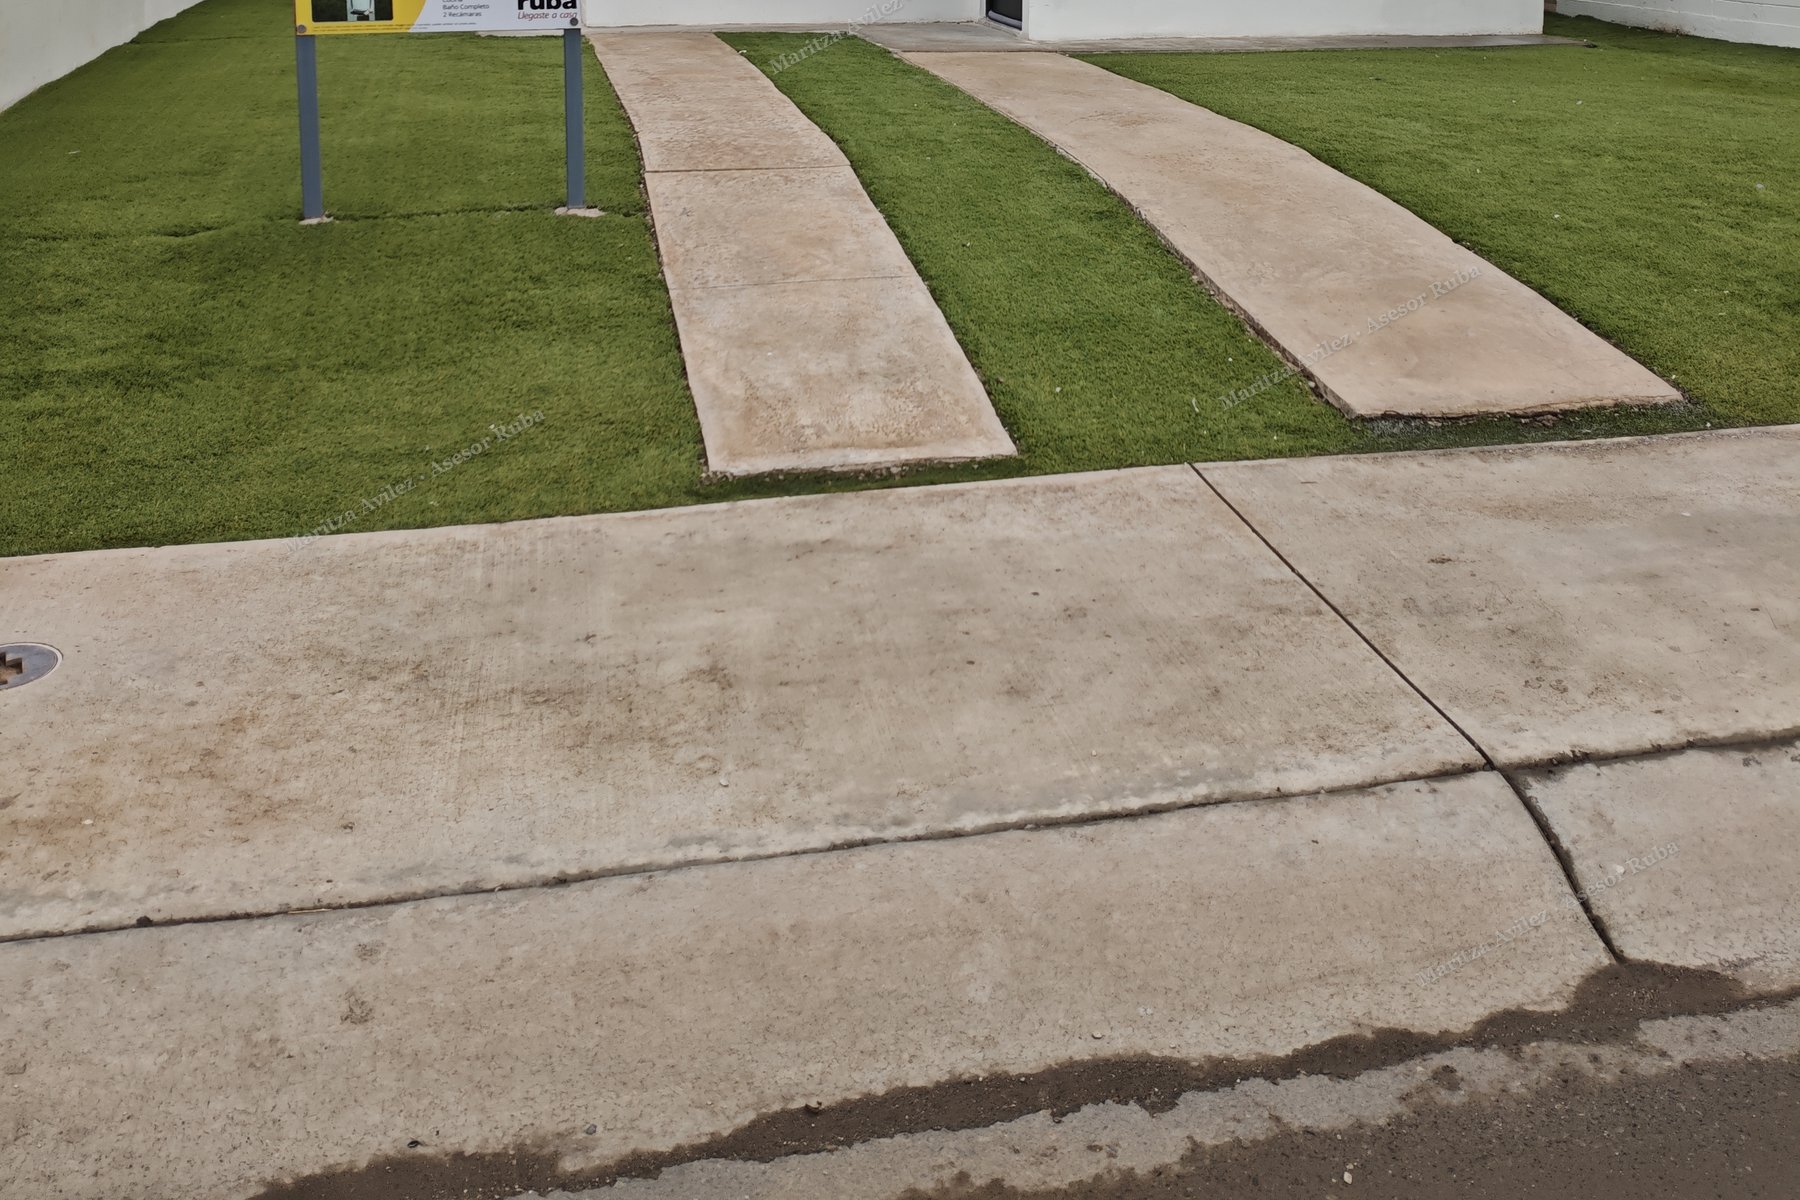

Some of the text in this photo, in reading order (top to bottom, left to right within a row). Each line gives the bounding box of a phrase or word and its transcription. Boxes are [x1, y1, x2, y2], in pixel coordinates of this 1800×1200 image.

[460, 3, 490, 11] Completo
[517, 10, 550, 21] Llegaste
[559, 11, 578, 19] casa
